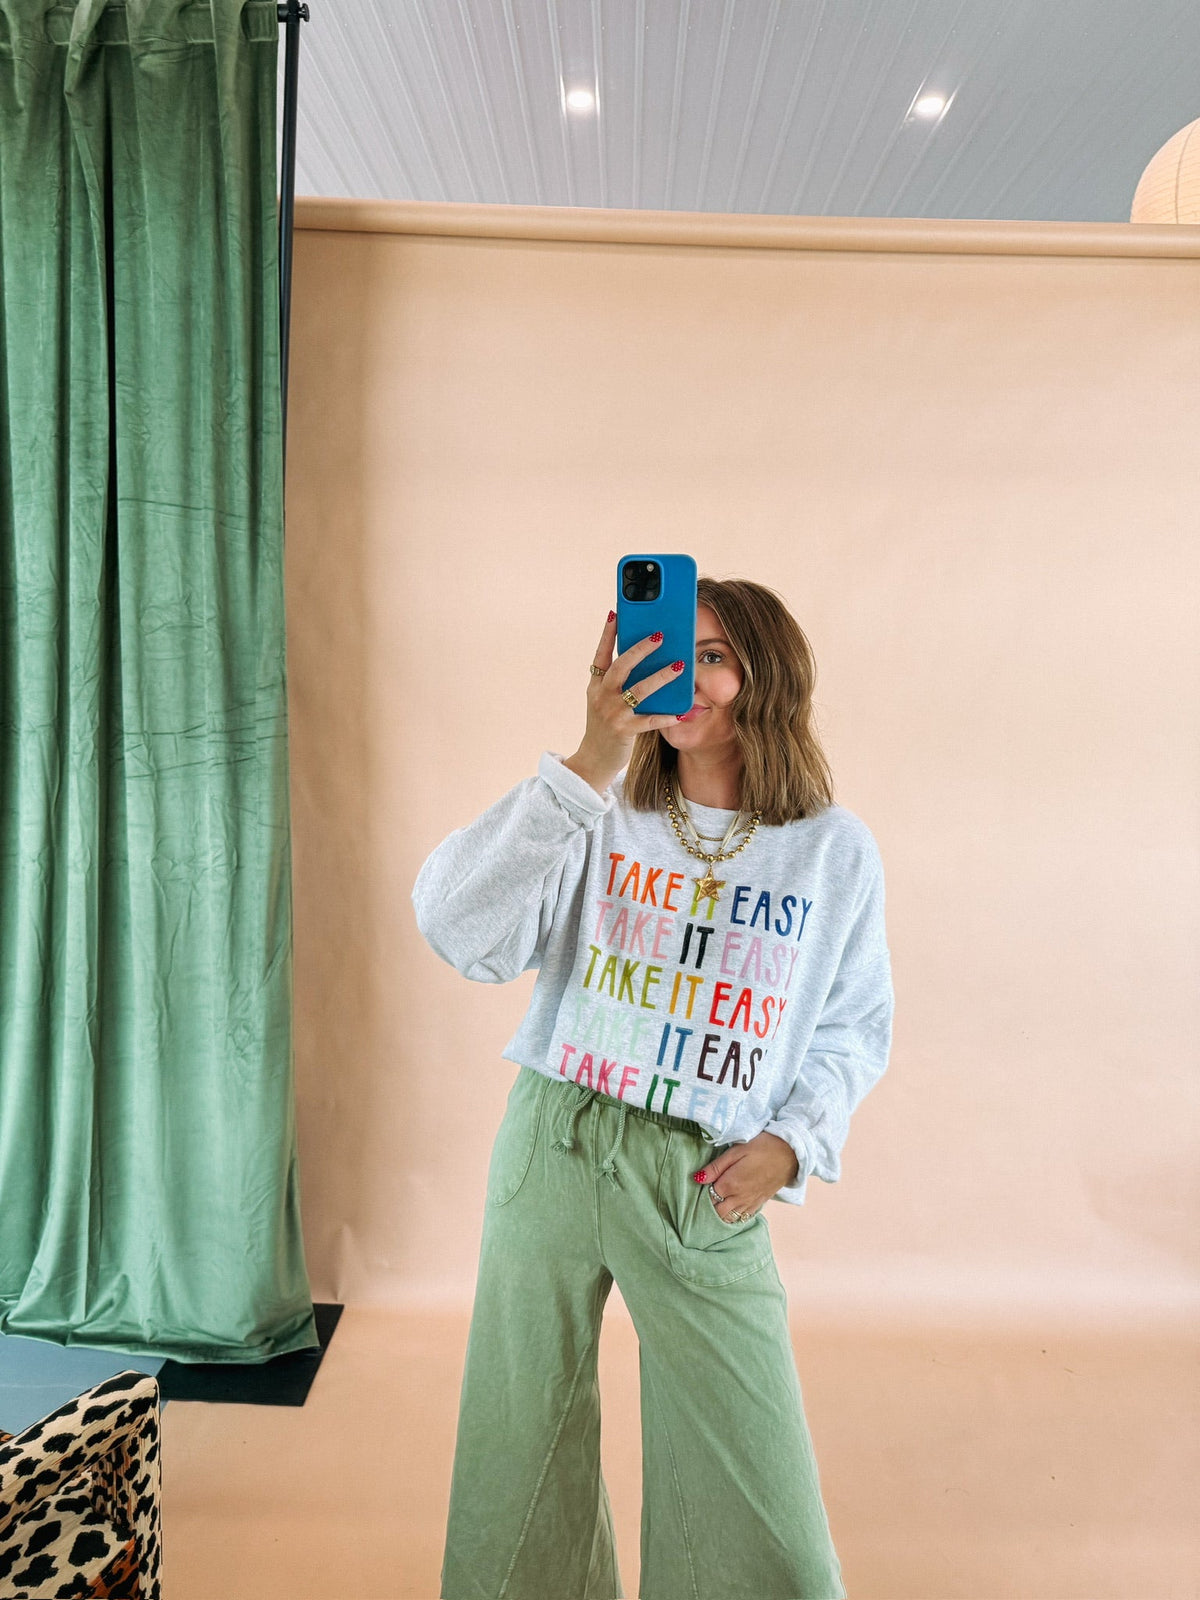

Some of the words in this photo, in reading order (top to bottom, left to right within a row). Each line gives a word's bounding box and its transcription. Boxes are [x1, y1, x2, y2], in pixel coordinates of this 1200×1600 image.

[606, 852, 684, 912] TAKE
[730, 886, 813, 942] EASY
[596, 900, 674, 960] TAKE
[679, 922, 715, 969] IT
[719, 931, 799, 991] EASY
[583, 944, 663, 1010] TAKE
[669, 971, 705, 1020] IT
[708, 981, 787, 1040] EASY
[571, 993, 651, 1061] TAKE
[656, 1022, 694, 1072] IT
[697, 1033, 768, 1092] EAS
[645, 1073, 681, 1116] IT
